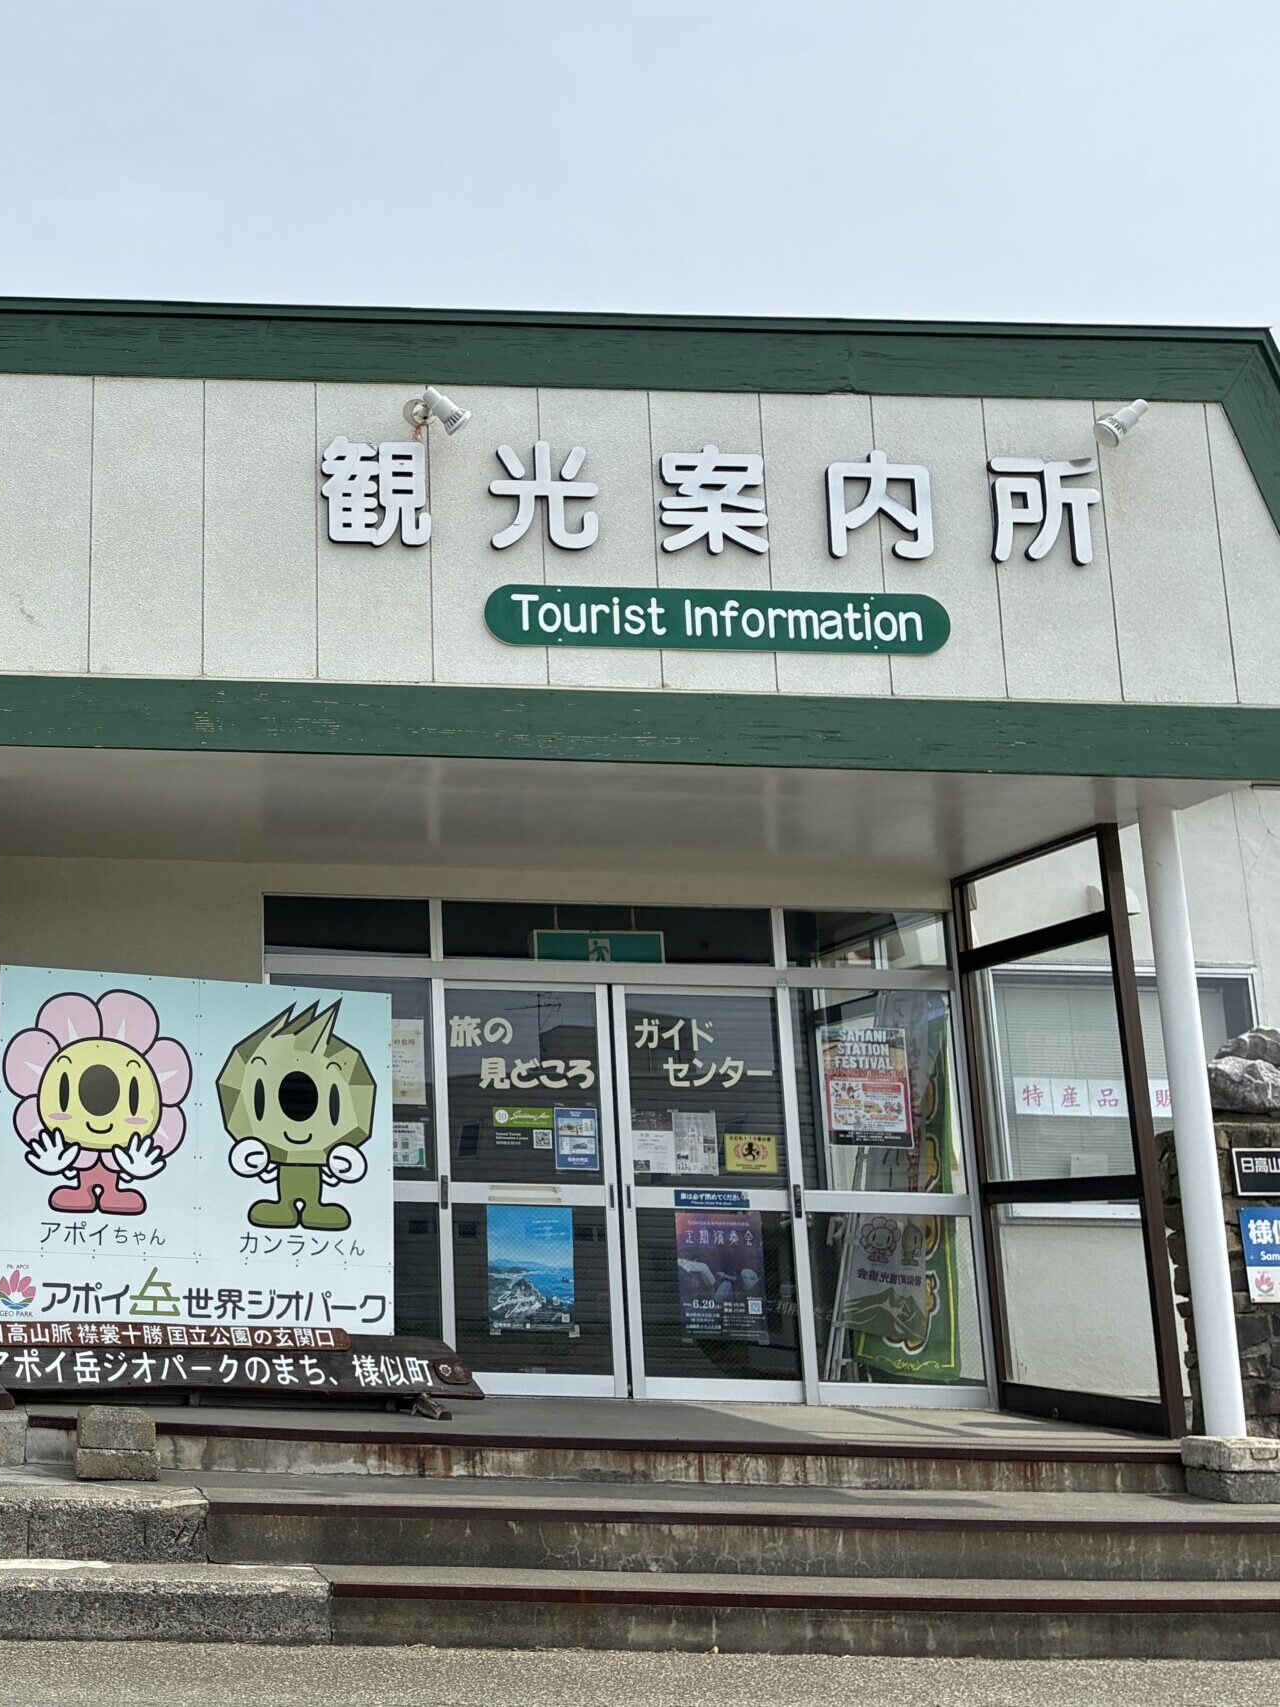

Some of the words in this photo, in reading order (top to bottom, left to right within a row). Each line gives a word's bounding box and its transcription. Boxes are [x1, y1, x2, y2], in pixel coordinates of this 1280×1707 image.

[321, 435, 1102, 567] 観光案内所
[511, 592, 668, 637] Tourist
[684, 597, 925, 644] Information
[449, 1016, 513, 1047] 旅の
[634, 1018, 714, 1051] ガイド
[839, 1029, 887, 1042] SAMANI
[835, 1056, 893, 1069] FESTIVAL
[837, 1043, 889, 1056] STATION
[479, 1057, 595, 1089] 見どころ
[663, 1057, 773, 1088] センター
[40, 1222, 166, 1246] アポイちゃん
[240, 1232, 365, 1257] カンランくん
[684, 1230, 754, 1246] 定期演奏会
[1248, 1219, 1280, 1245] 様
[41, 1267, 388, 1323] アポイ岳世界ジオパーク
